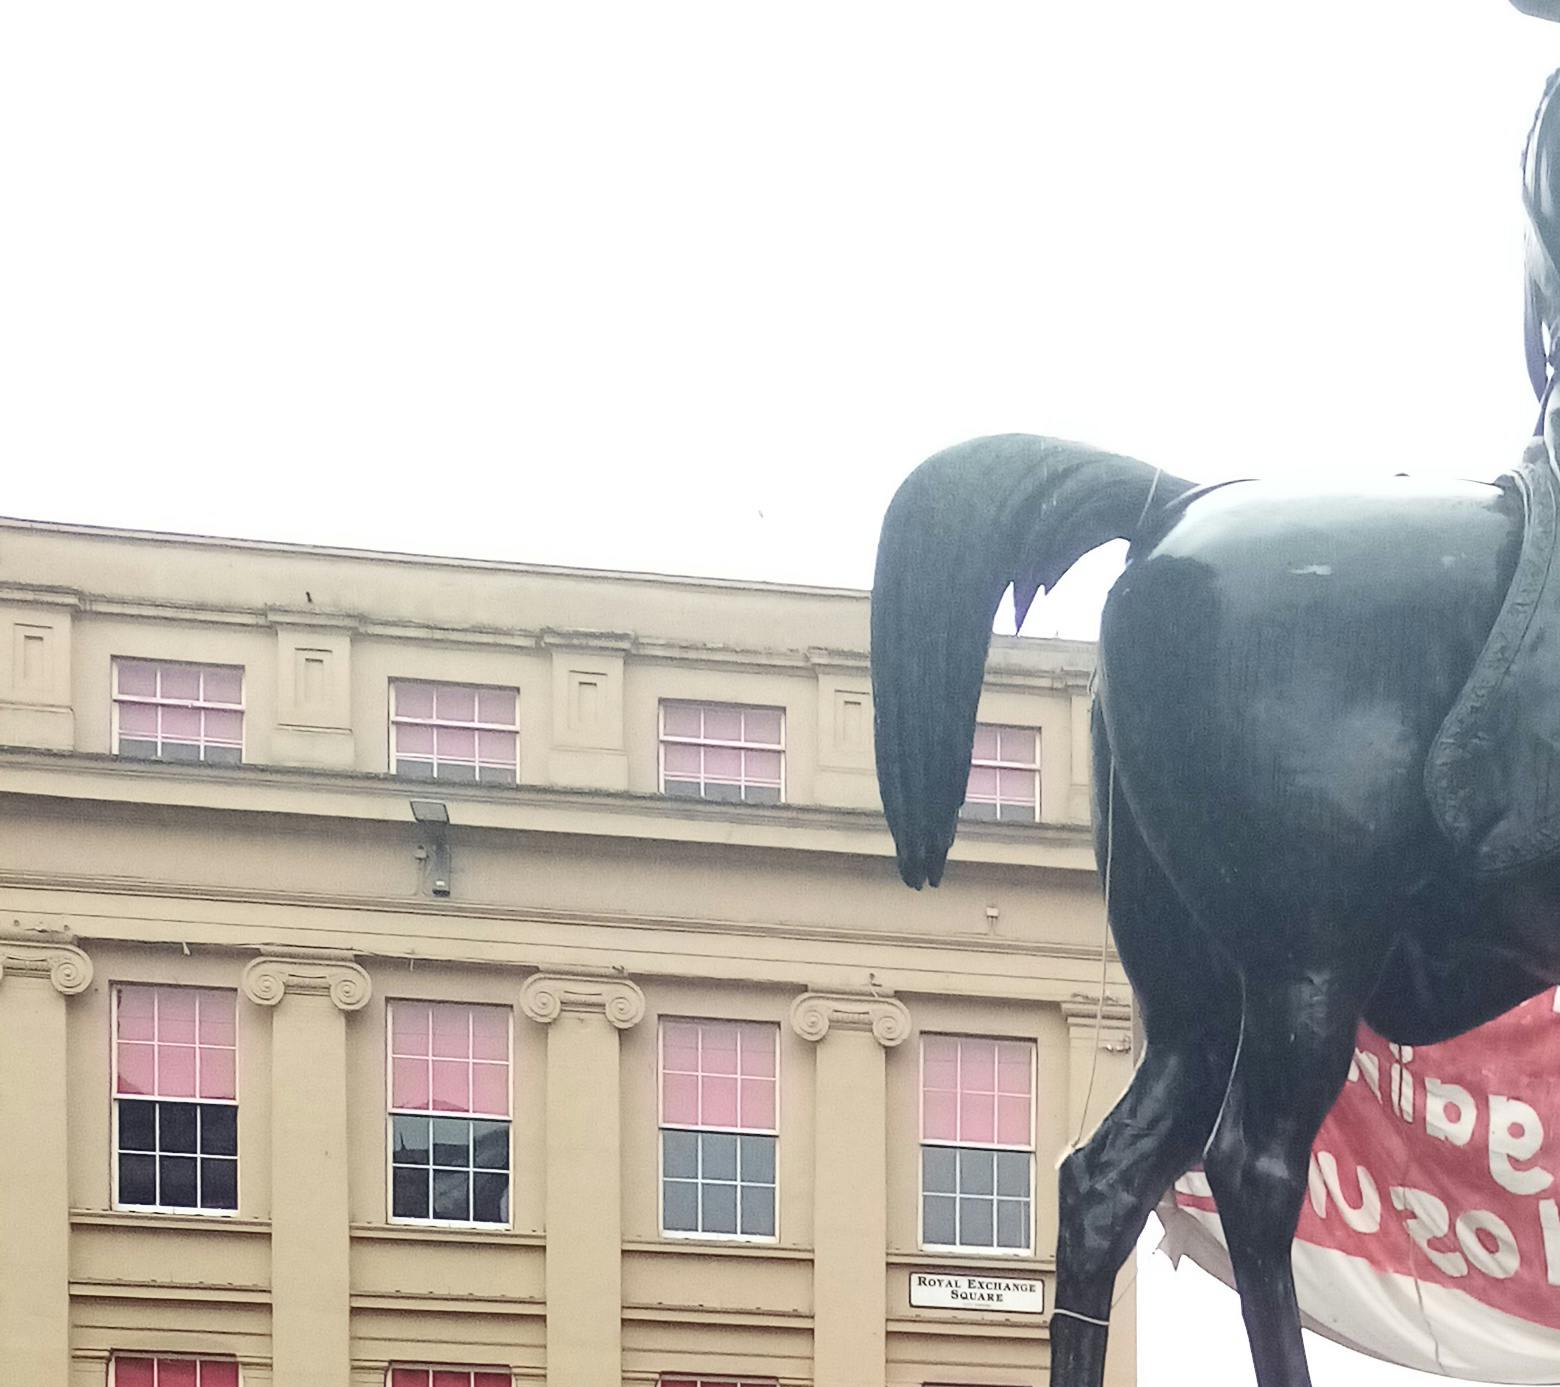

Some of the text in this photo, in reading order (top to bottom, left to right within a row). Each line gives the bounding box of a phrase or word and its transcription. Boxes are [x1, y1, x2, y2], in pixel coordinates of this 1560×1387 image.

[917, 1276, 1037, 1293] ROYAL EXCHANGE
[950, 1290, 1004, 1302] SQUARE
